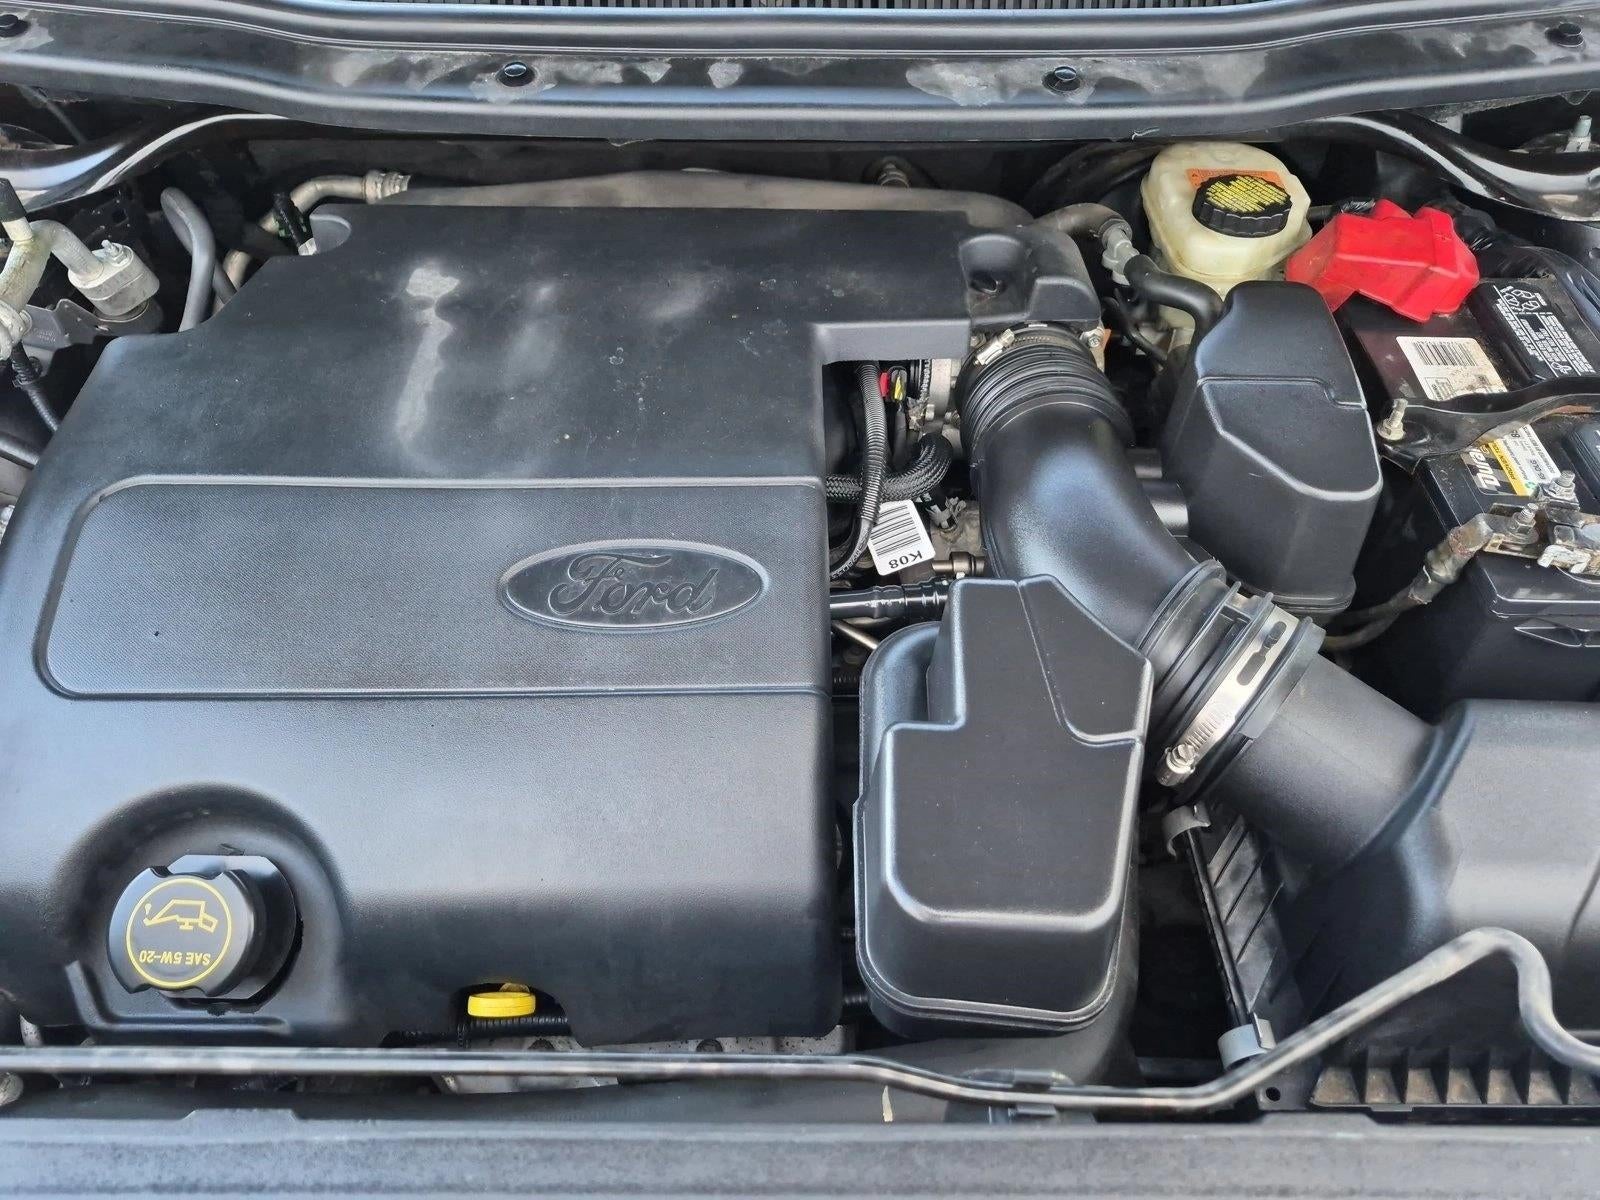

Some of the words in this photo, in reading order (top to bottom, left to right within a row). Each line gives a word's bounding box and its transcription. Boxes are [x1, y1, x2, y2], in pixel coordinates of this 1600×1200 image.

[889, 550, 922, 569] K08
[548, 553, 719, 615] Ford
[139, 949, 182, 965] 5W-20
[185, 951, 211, 966] SAE
